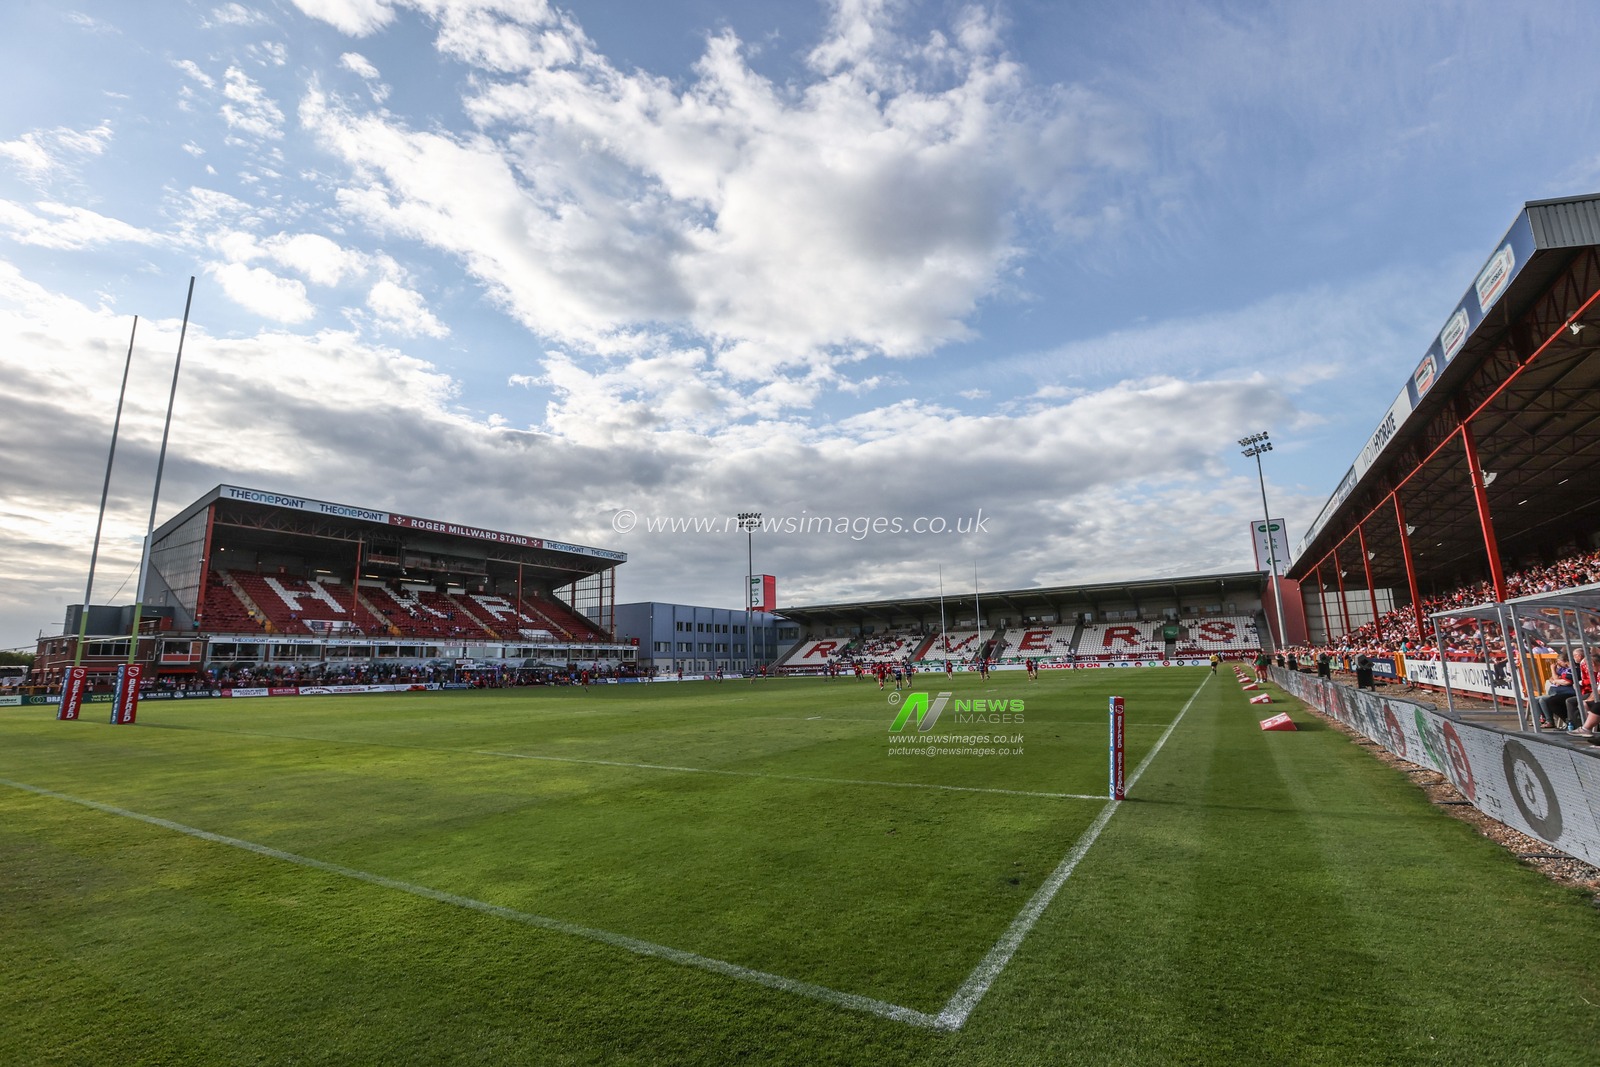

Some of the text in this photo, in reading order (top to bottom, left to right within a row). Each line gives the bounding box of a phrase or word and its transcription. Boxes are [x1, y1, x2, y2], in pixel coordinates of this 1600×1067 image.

[411, 519, 528, 545] ROGER MILLWARD STAND
[65, 679, 81, 719] BETFRED
[123, 678, 136, 722] BETFRED
